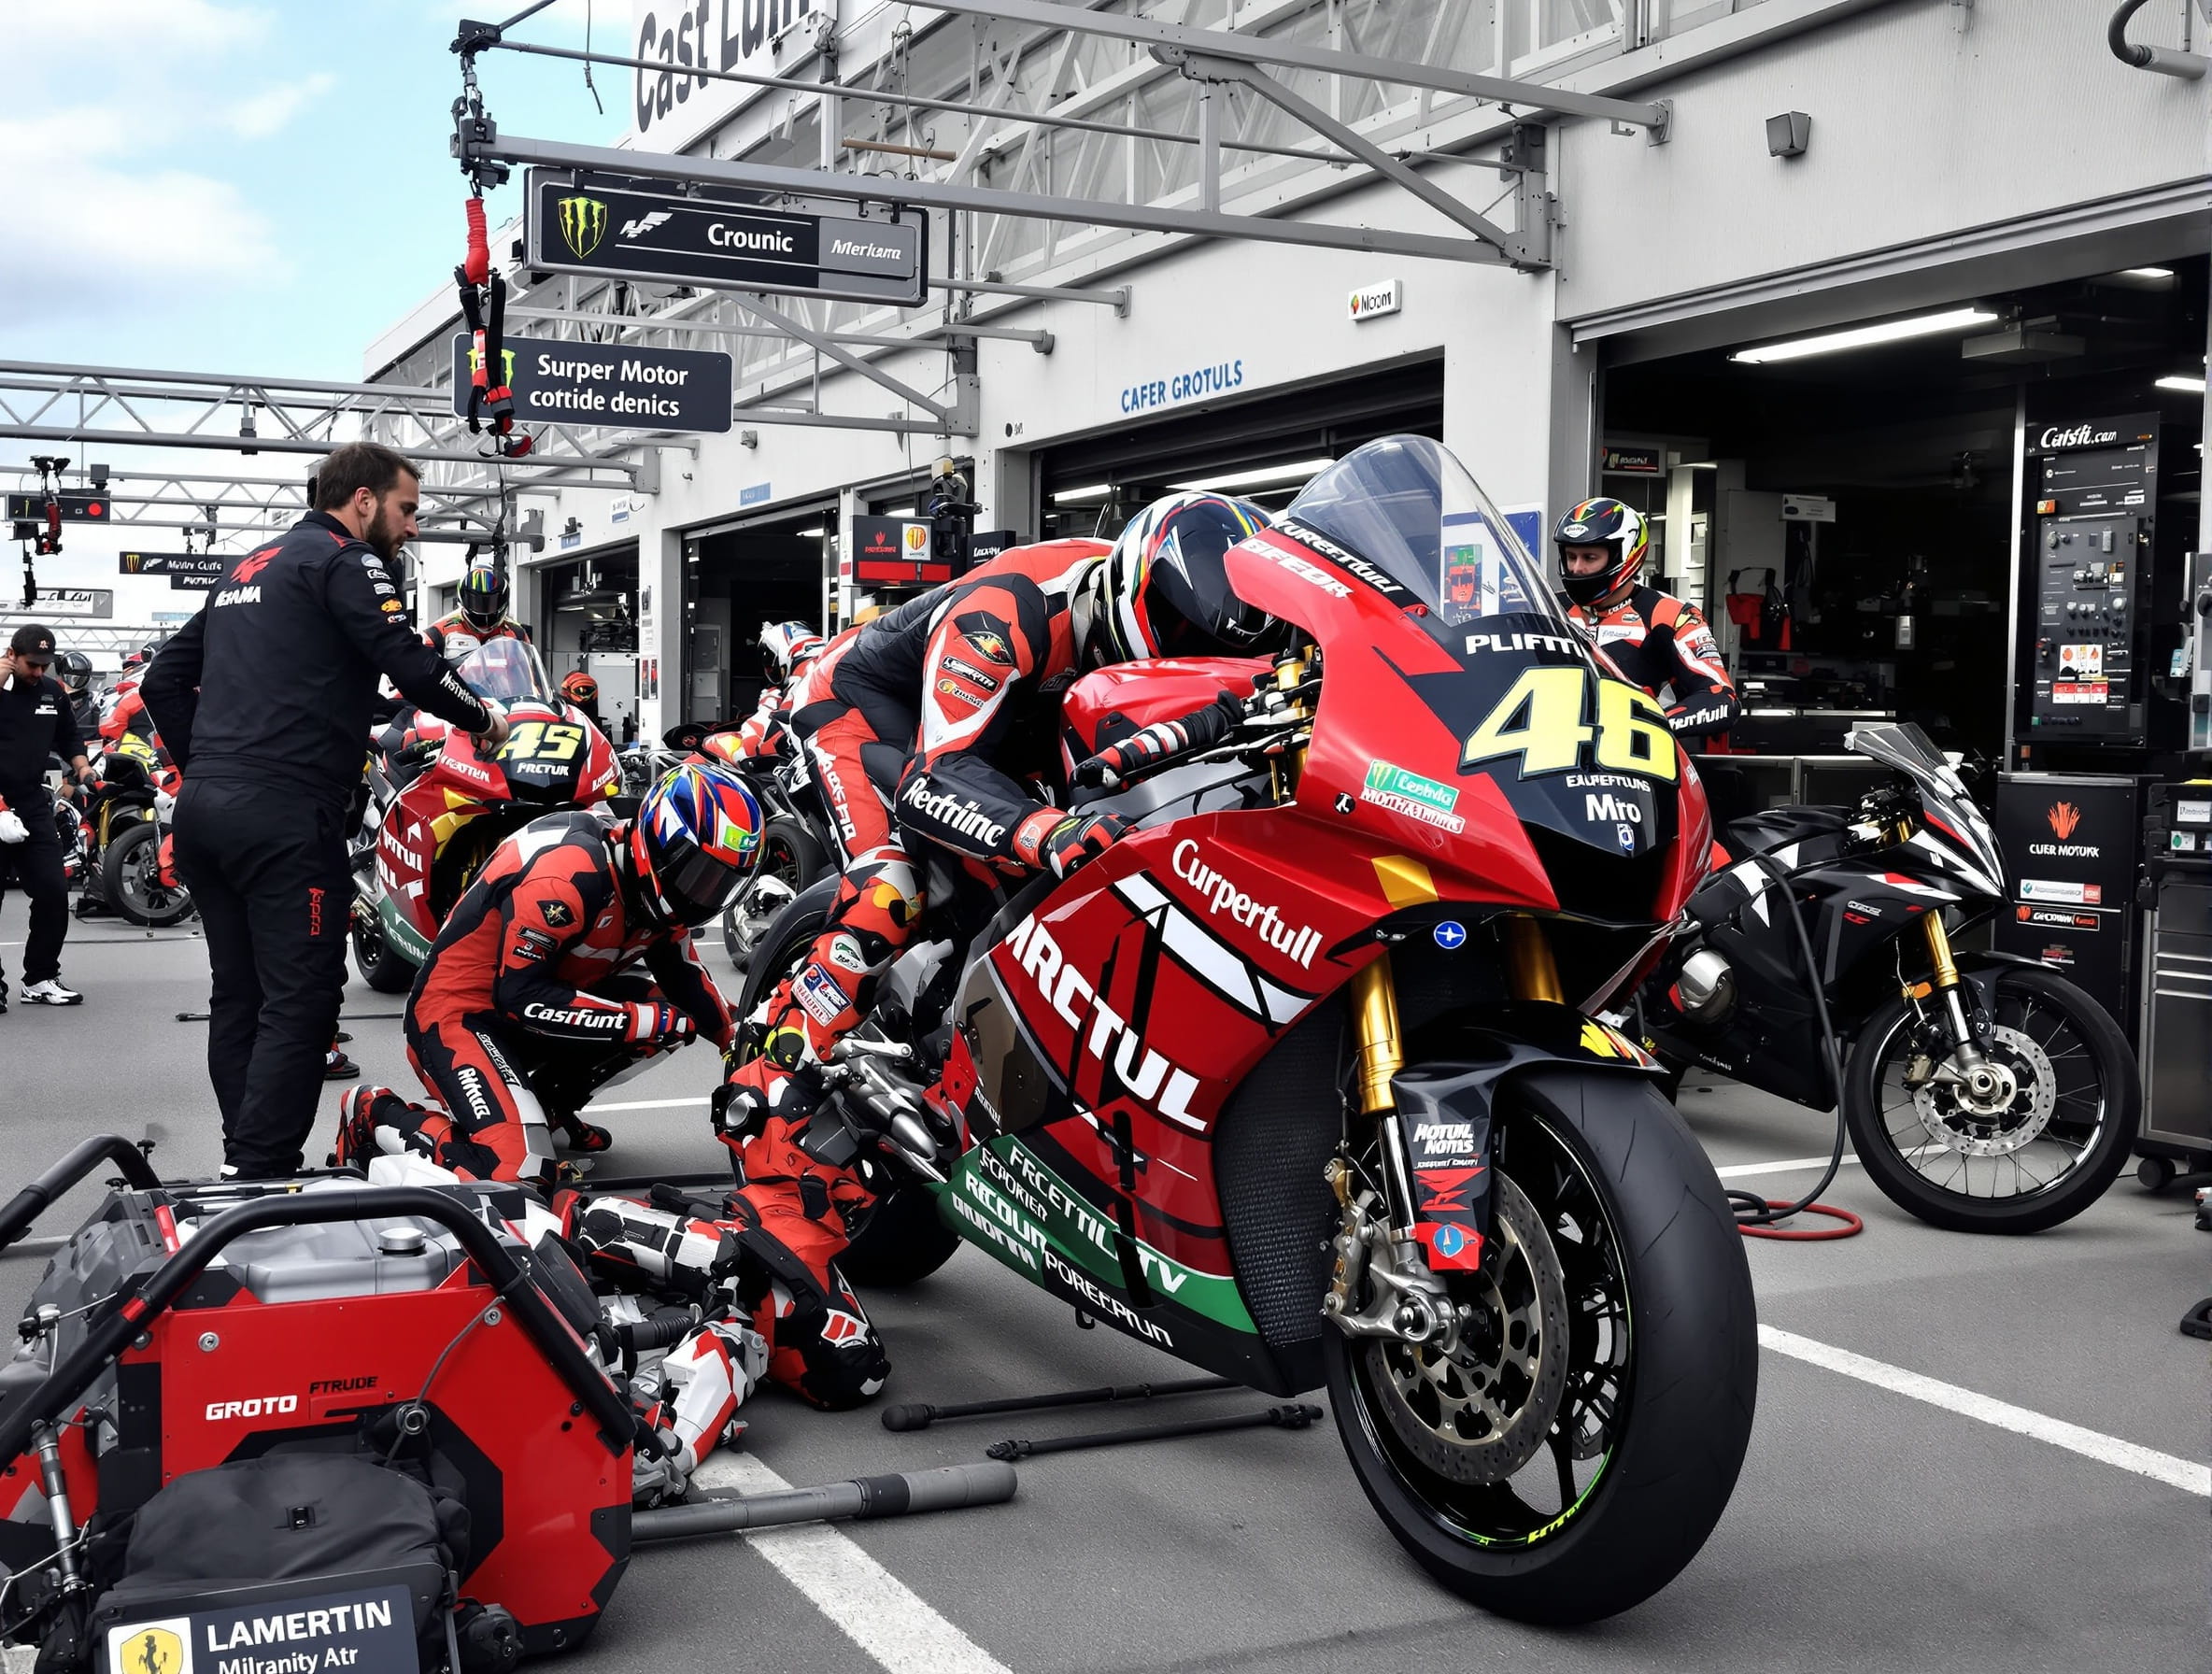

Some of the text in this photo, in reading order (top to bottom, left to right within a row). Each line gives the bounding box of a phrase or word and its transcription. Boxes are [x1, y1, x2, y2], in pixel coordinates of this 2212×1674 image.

[707, 222, 793, 253] Crounic
[537, 354, 688, 386] Surper Motor
[1121, 360, 1243, 413] CAFER GROTULS
[611, 390, 680, 417] denics
[1462, 666, 1679, 782] 46
[309, 1376, 378, 1395] FTRUDE
[206, 1395, 298, 1421] GROTO
[206, 1599, 392, 1653] LAMERTIN
[324, 1647, 359, 1667] Atr
